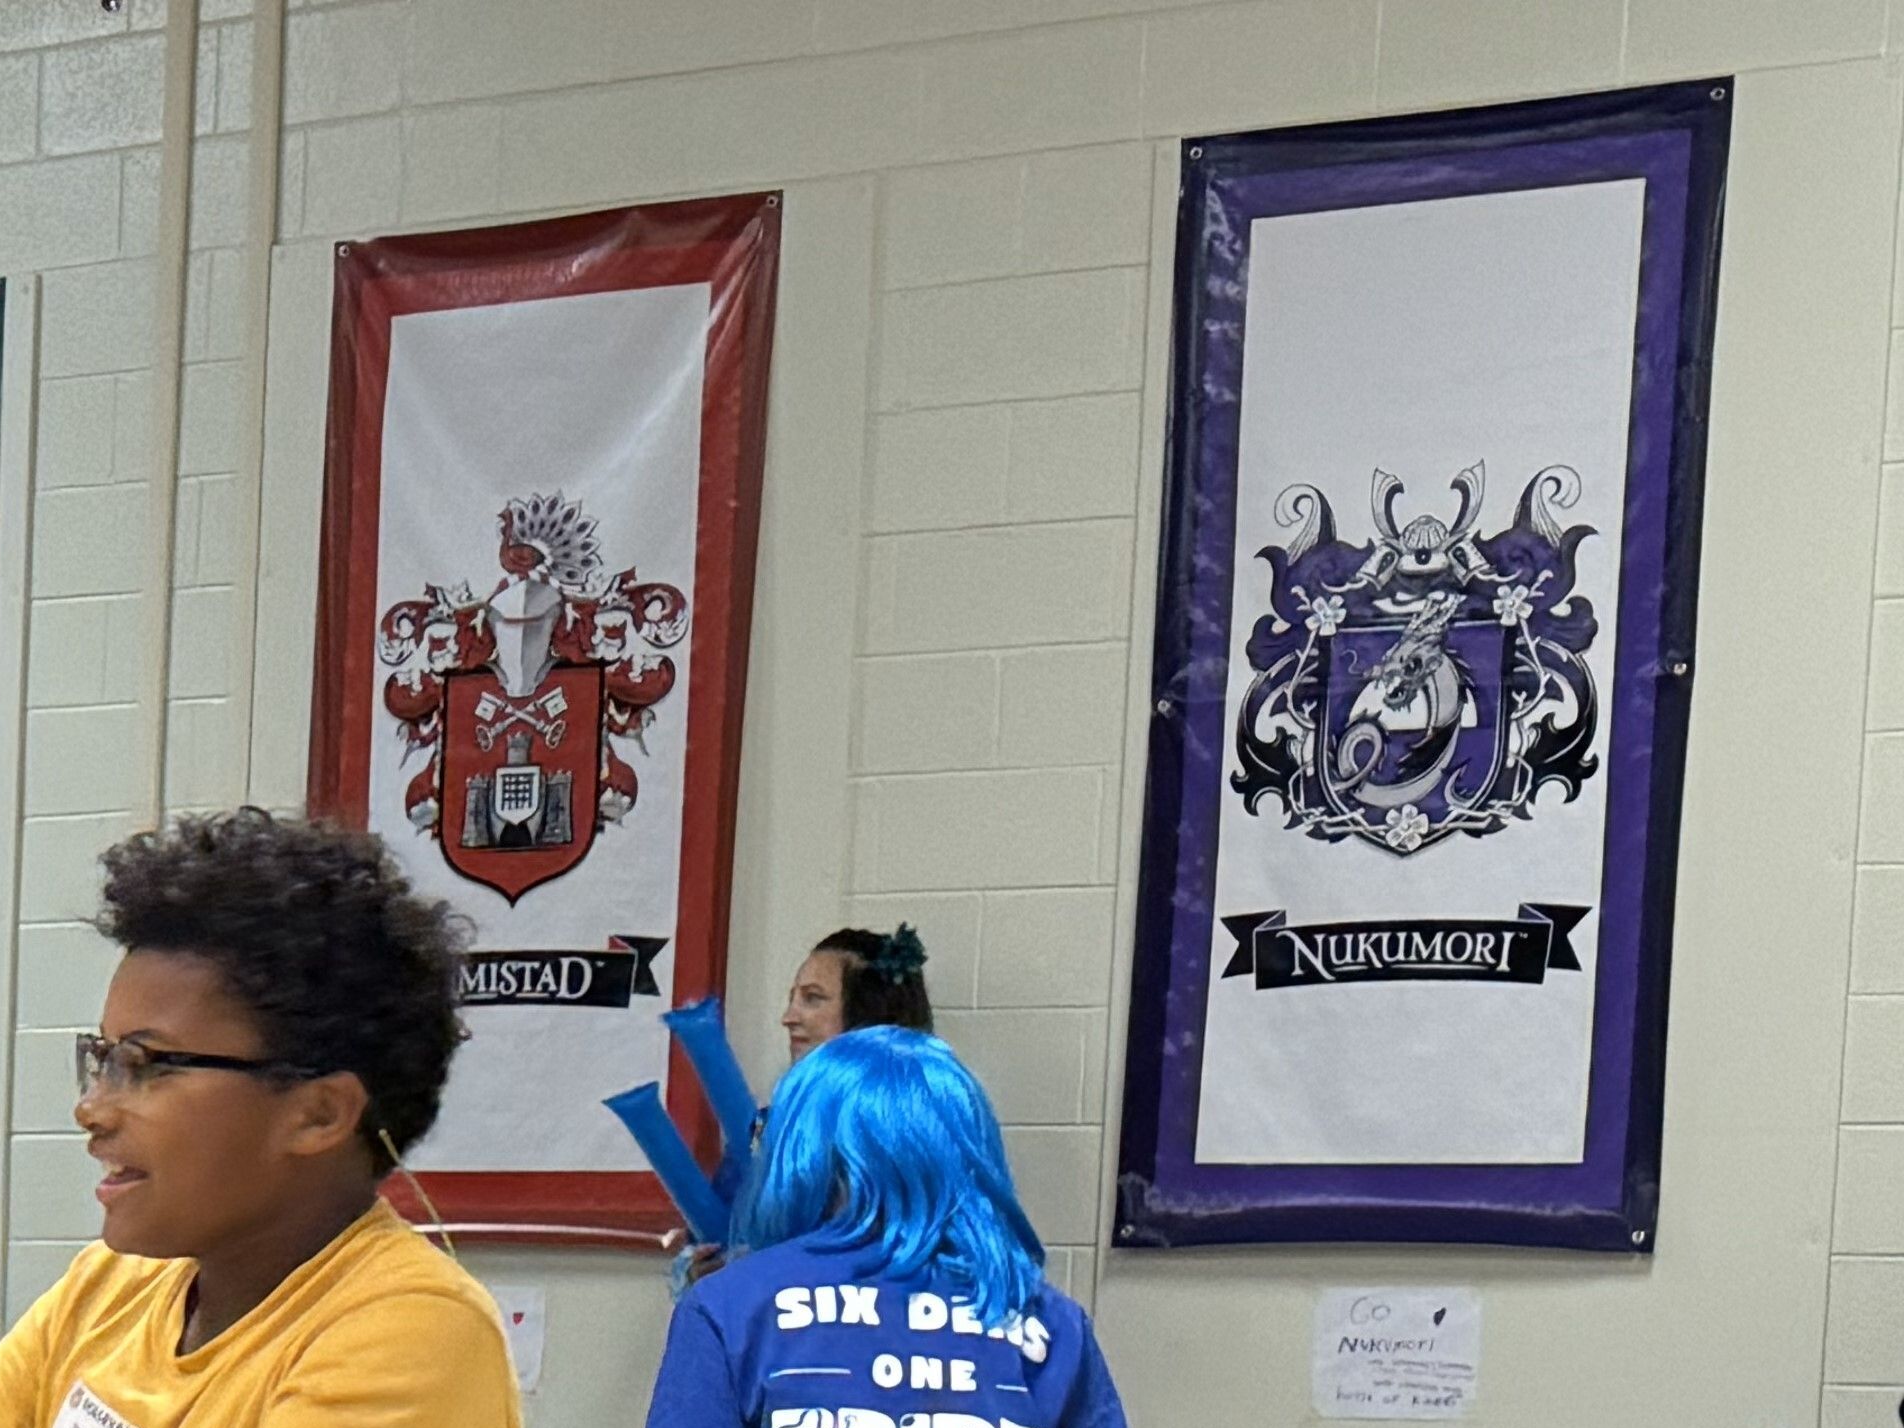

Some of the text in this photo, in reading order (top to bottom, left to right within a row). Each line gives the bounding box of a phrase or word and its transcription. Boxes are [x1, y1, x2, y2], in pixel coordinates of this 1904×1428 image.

[1276, 929, 1518, 981] NUKUMORI
[459, 956, 592, 999] MISTAD
[775, 1285, 879, 1330] SIX
[872, 1353, 977, 1392] ONE
